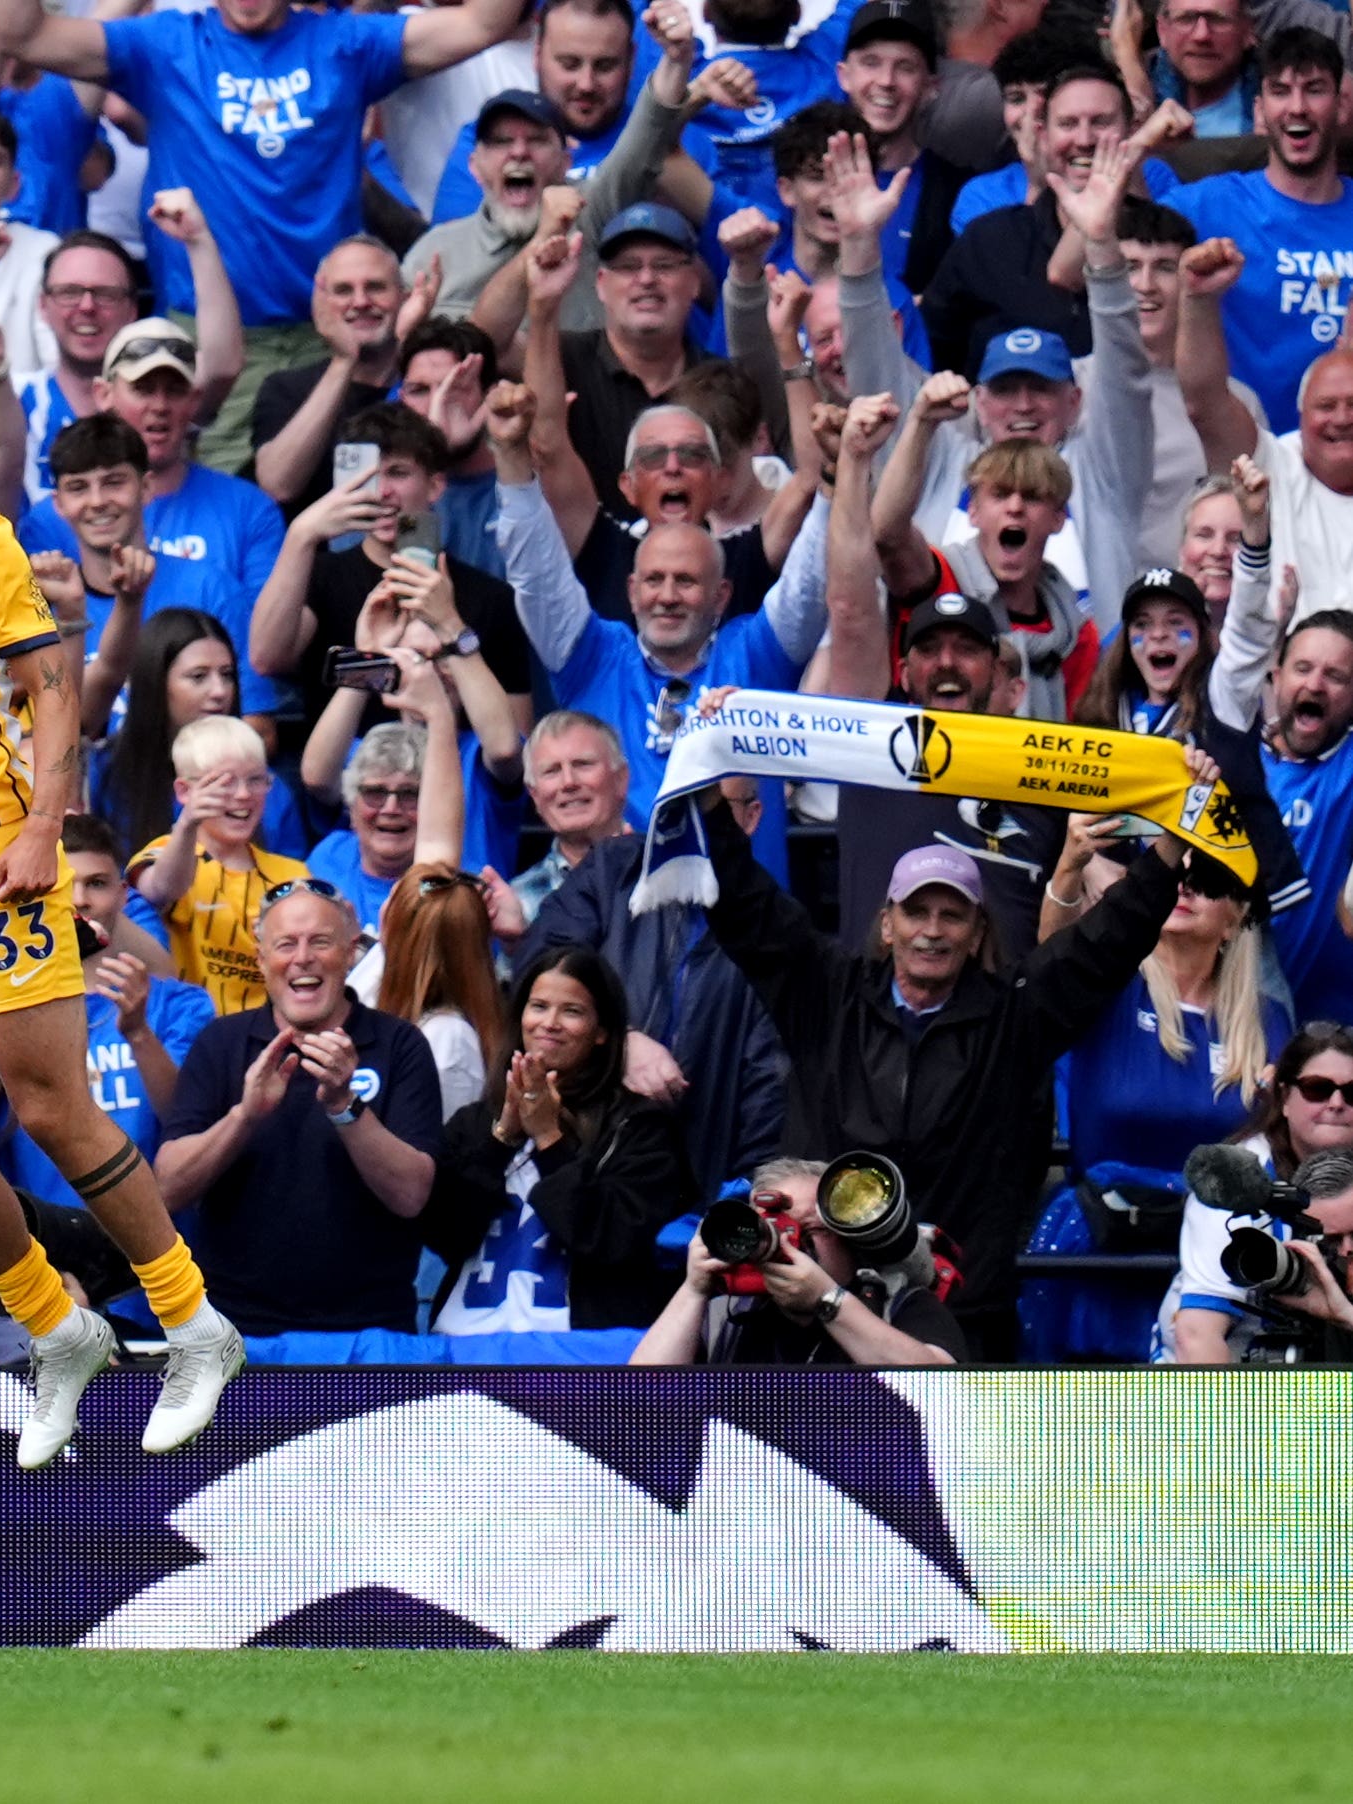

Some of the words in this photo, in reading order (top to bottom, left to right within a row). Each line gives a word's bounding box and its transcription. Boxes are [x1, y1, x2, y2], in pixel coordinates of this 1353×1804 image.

[217, 67, 311, 105] STAND
[222, 98, 316, 134] FALL
[1280, 280, 1353, 316] FAL
[787, 712, 806, 730] &
[812, 716, 869, 736] HOVE
[731, 735, 808, 757] ALBION
[1023, 734, 1074, 754] AEK
[1082, 739, 1114, 759] FC
[1018, 777, 1051, 792] AEK
[1055, 782, 1110, 799] ARENA
